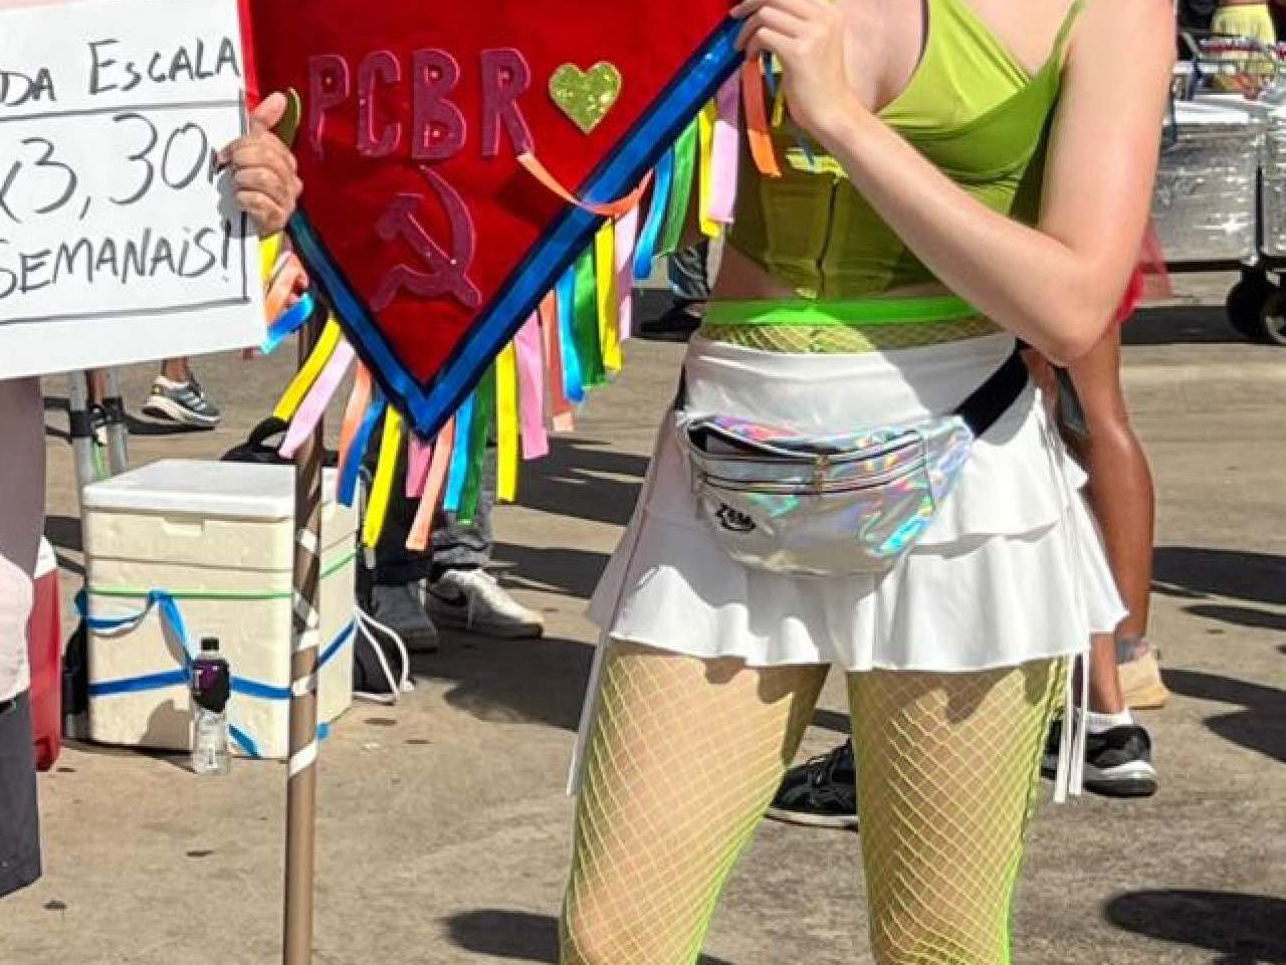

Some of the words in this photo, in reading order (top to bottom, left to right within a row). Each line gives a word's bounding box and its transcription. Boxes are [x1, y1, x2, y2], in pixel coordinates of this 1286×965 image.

[0, 70, 56, 106] DA
[87, 36, 241, 97] ESCALA
[307, 47, 535, 161] PCBR
